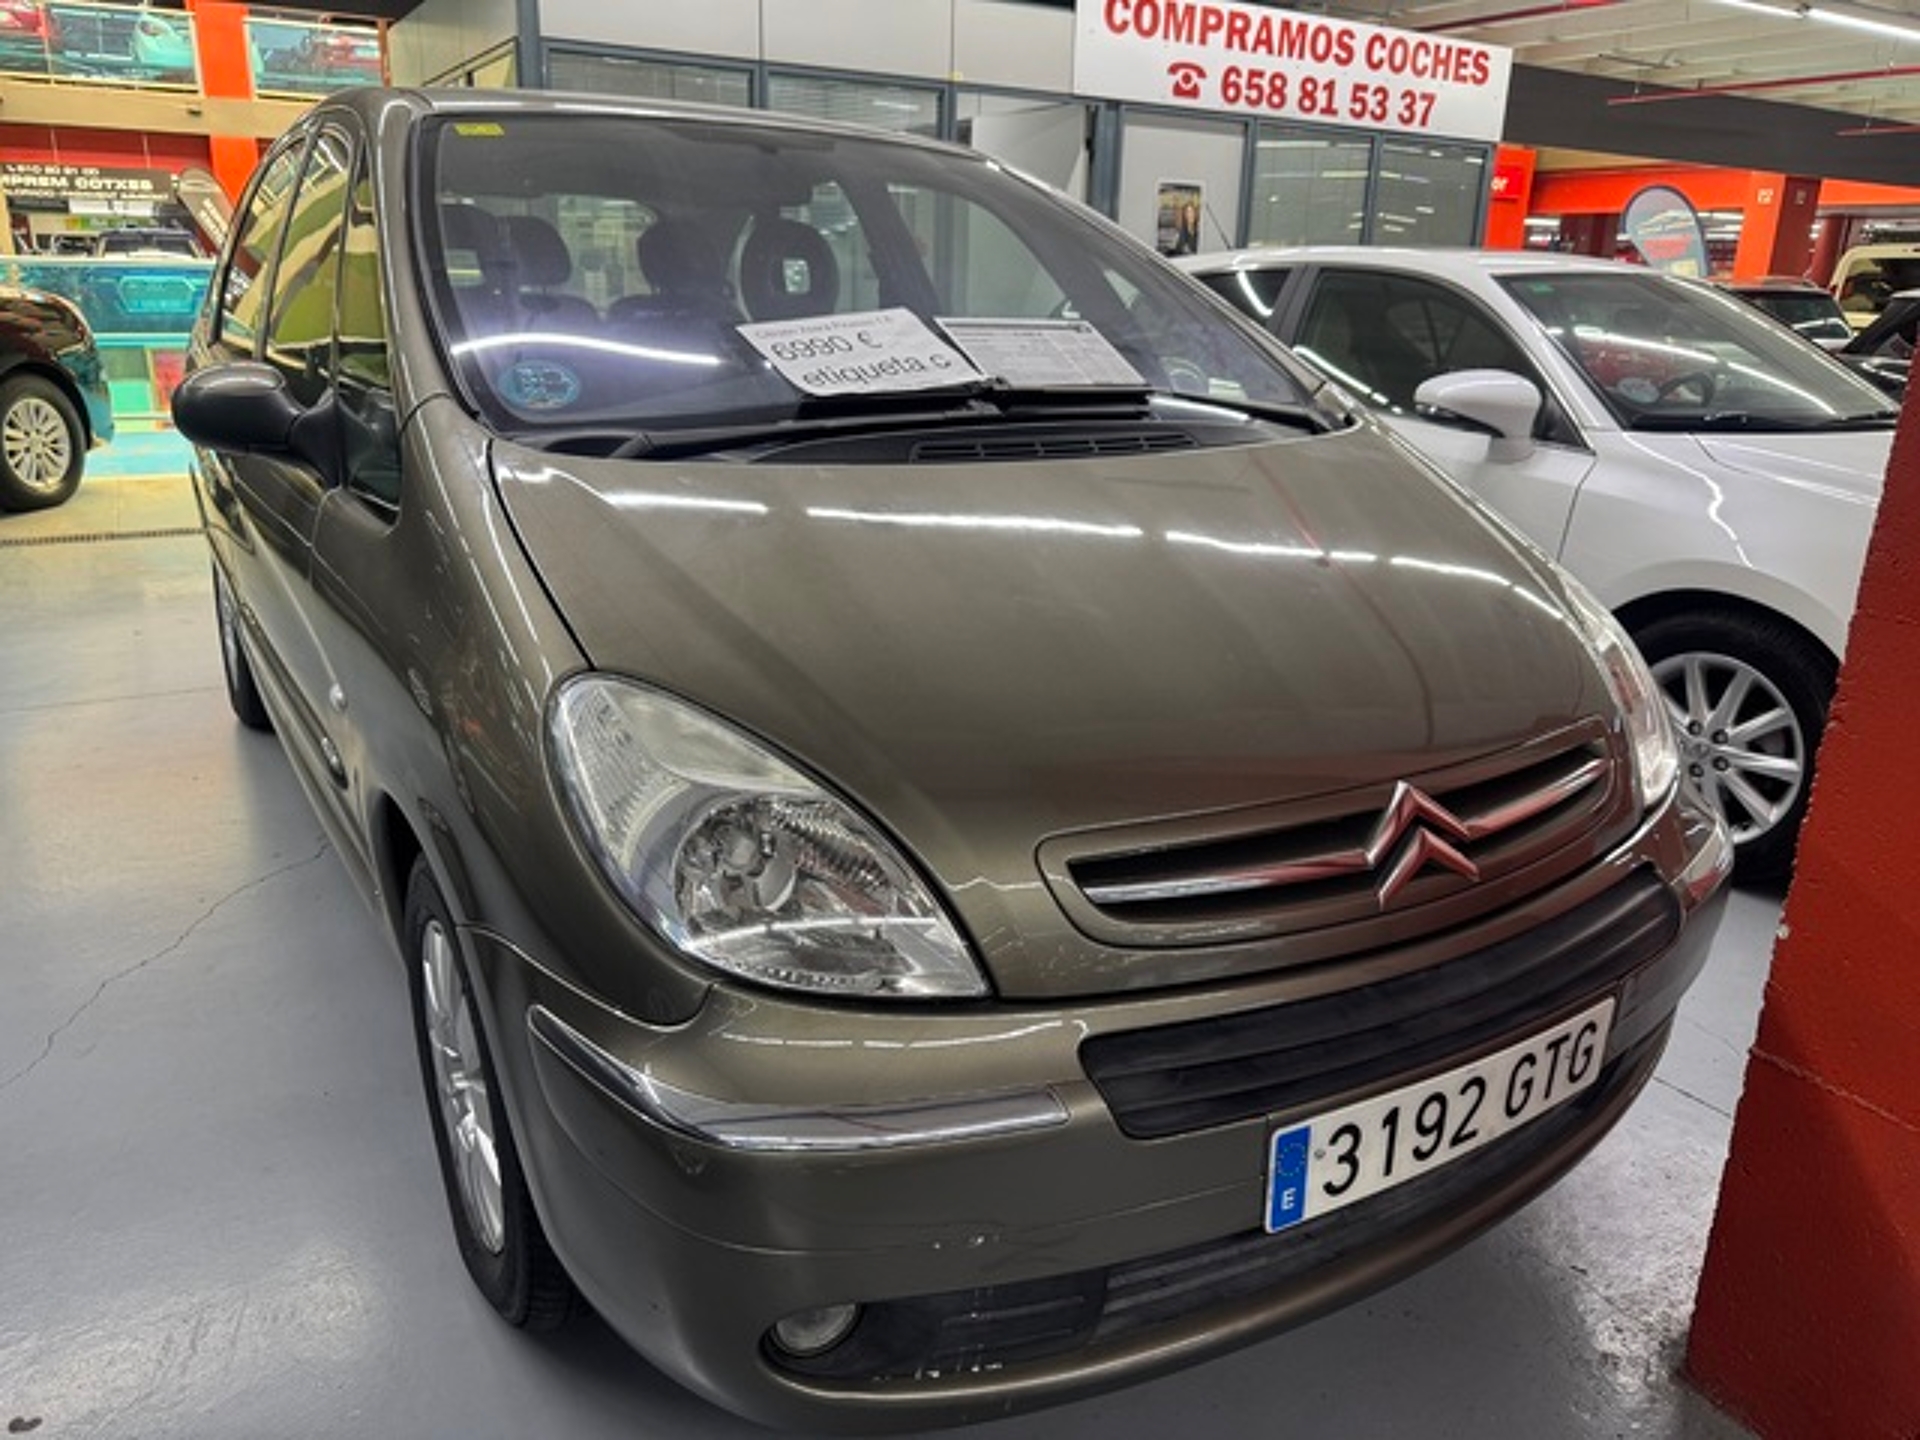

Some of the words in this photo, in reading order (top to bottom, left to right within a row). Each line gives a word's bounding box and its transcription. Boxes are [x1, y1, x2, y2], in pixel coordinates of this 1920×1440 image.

[1103, 0, 1355, 67] COMPRAMOS
[1365, 32, 1491, 86] COCHES
[1220, 65, 1288, 109] 658
[1298, 76, 1339, 116] 81
[1348, 82, 1389, 123] 53
[1397, 89, 1438, 127] 37
[770, 334, 853, 361] 6990
[803, 356, 926, 387] etiqueta
[1322, 1076, 1487, 1196] 3192
[1504, 1020, 1597, 1118] GTG
[1281, 1186, 1296, 1210] E
